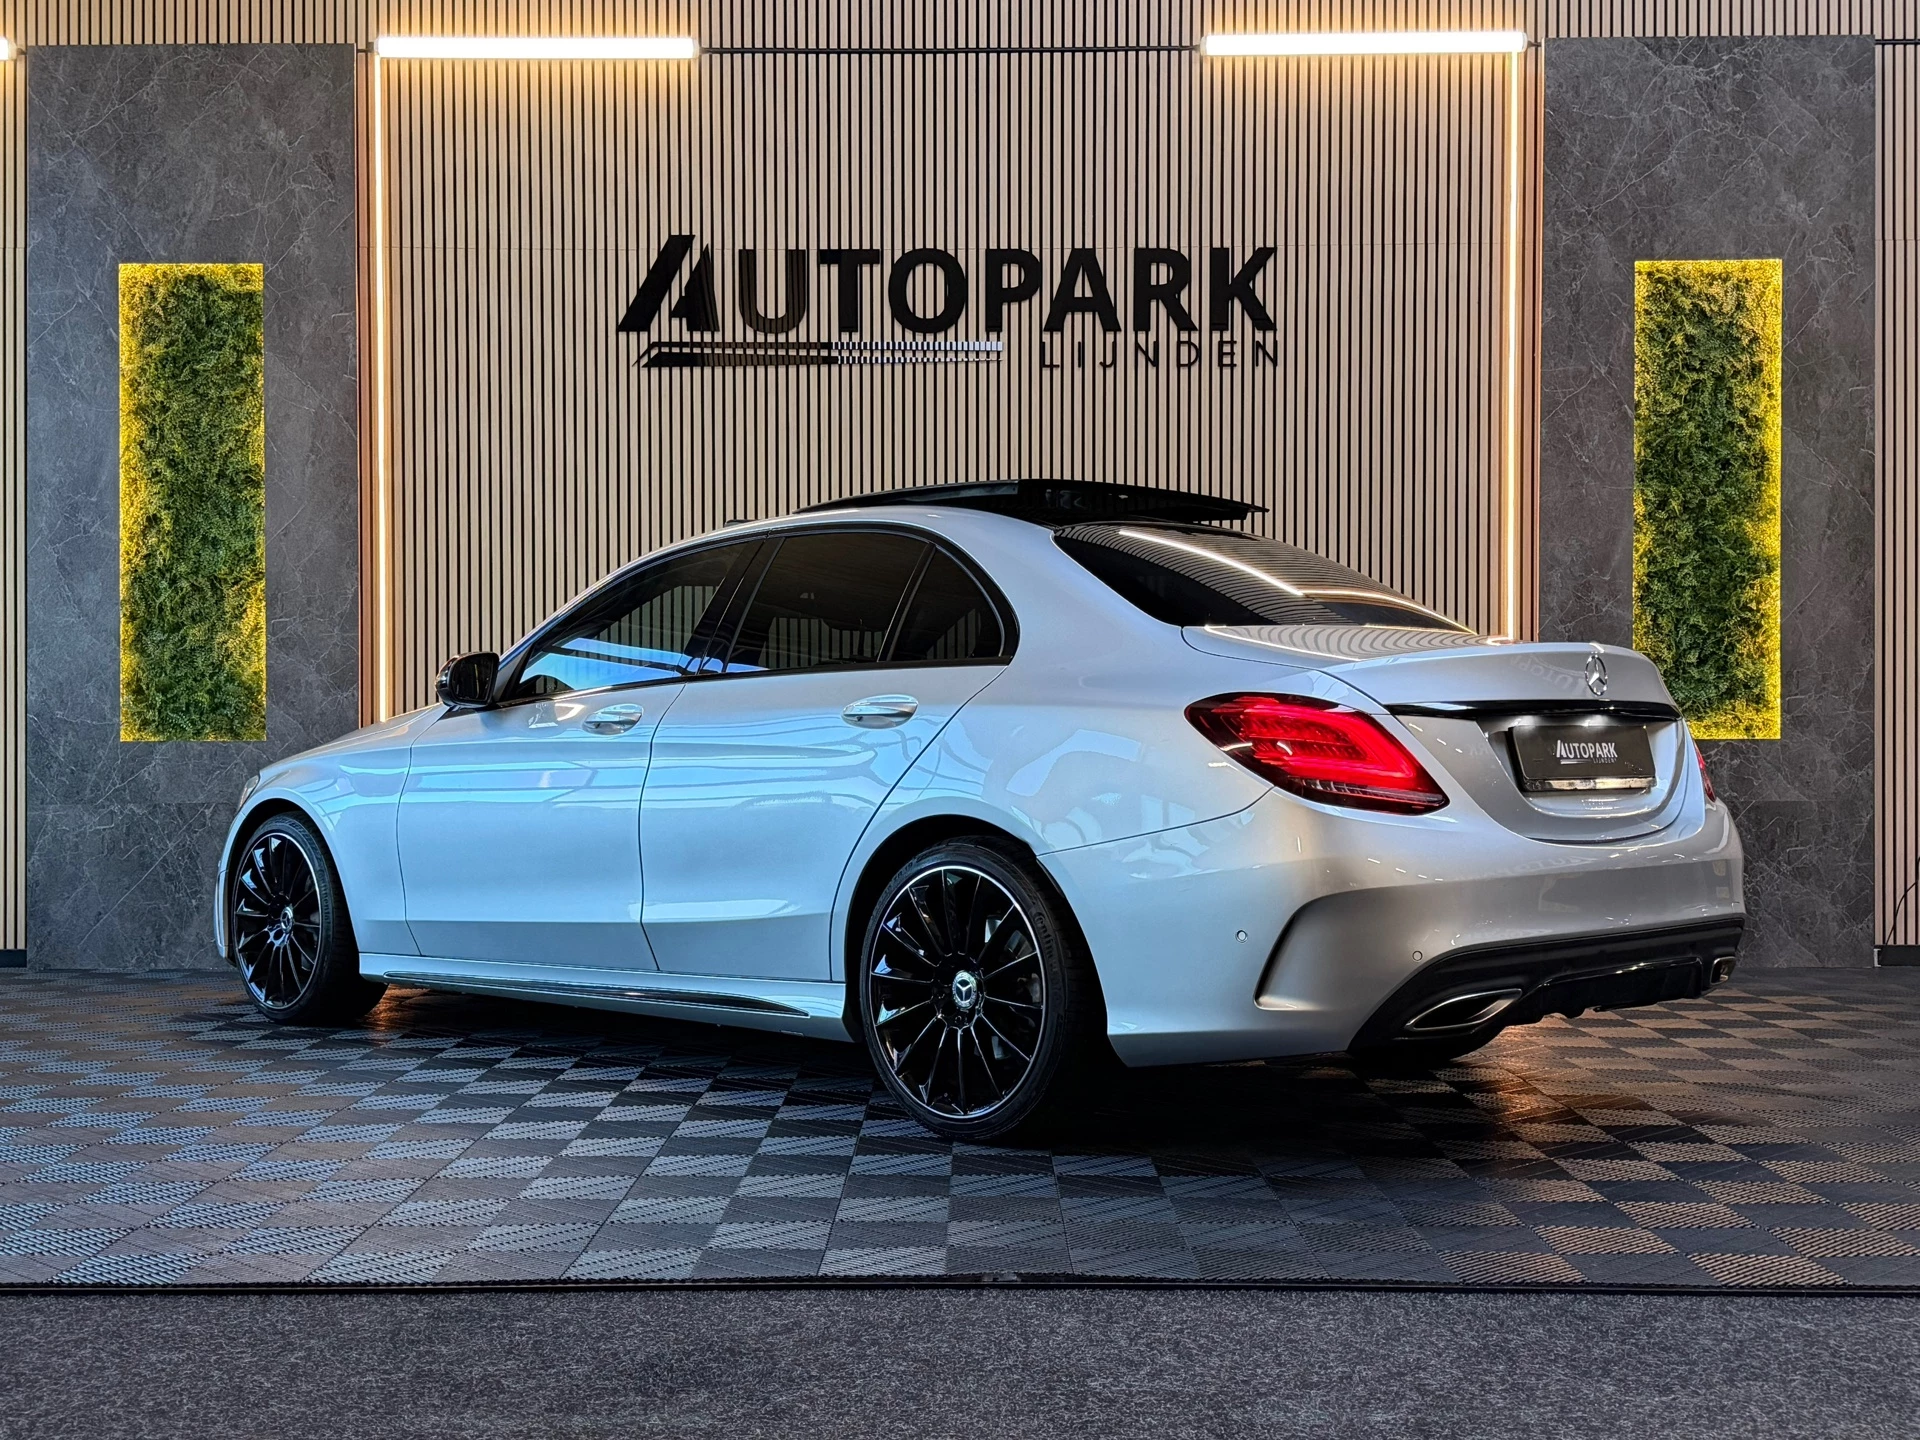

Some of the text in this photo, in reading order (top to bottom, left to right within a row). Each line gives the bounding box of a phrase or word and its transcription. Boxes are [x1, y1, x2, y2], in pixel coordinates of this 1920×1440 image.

[616, 234, 1277, 333] AUTOPARK
[1040, 340, 1279, 368] LIJNDEN
[1556, 739, 1618, 759] AUTOPARK
